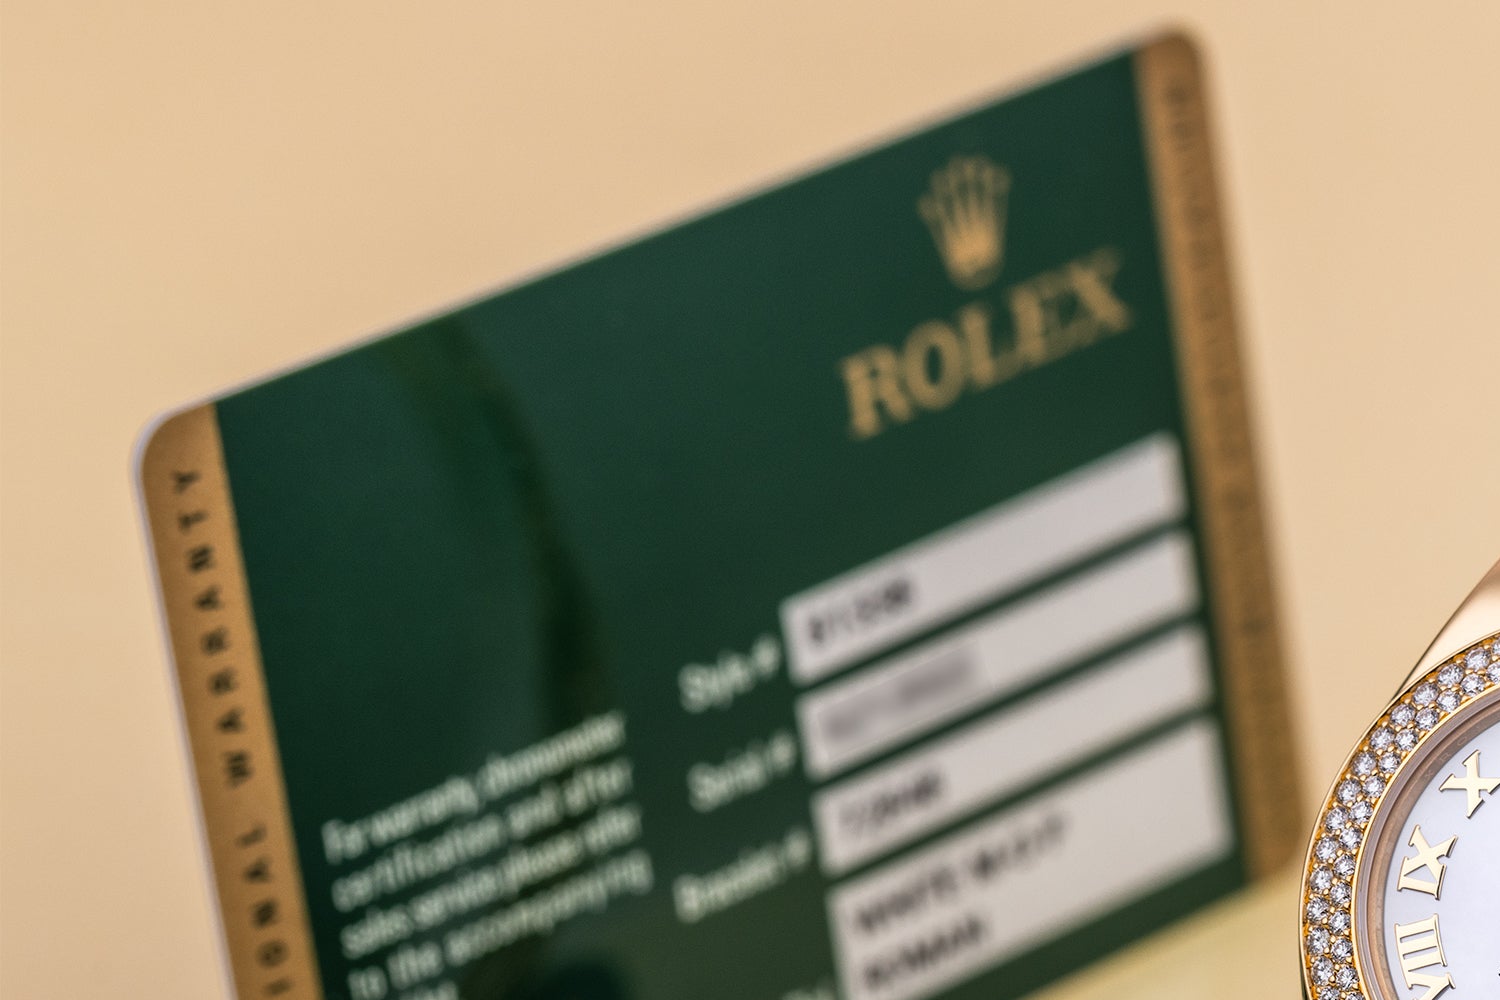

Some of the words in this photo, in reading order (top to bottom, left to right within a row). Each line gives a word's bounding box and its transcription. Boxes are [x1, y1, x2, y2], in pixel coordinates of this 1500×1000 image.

[838, 246, 1134, 440] ROLEX
[171, 468, 255, 789] WARRANTY
[321, 818, 368, 865] For
[1396, 824, 1459, 901] IX
[387, 941, 445, 990] the
